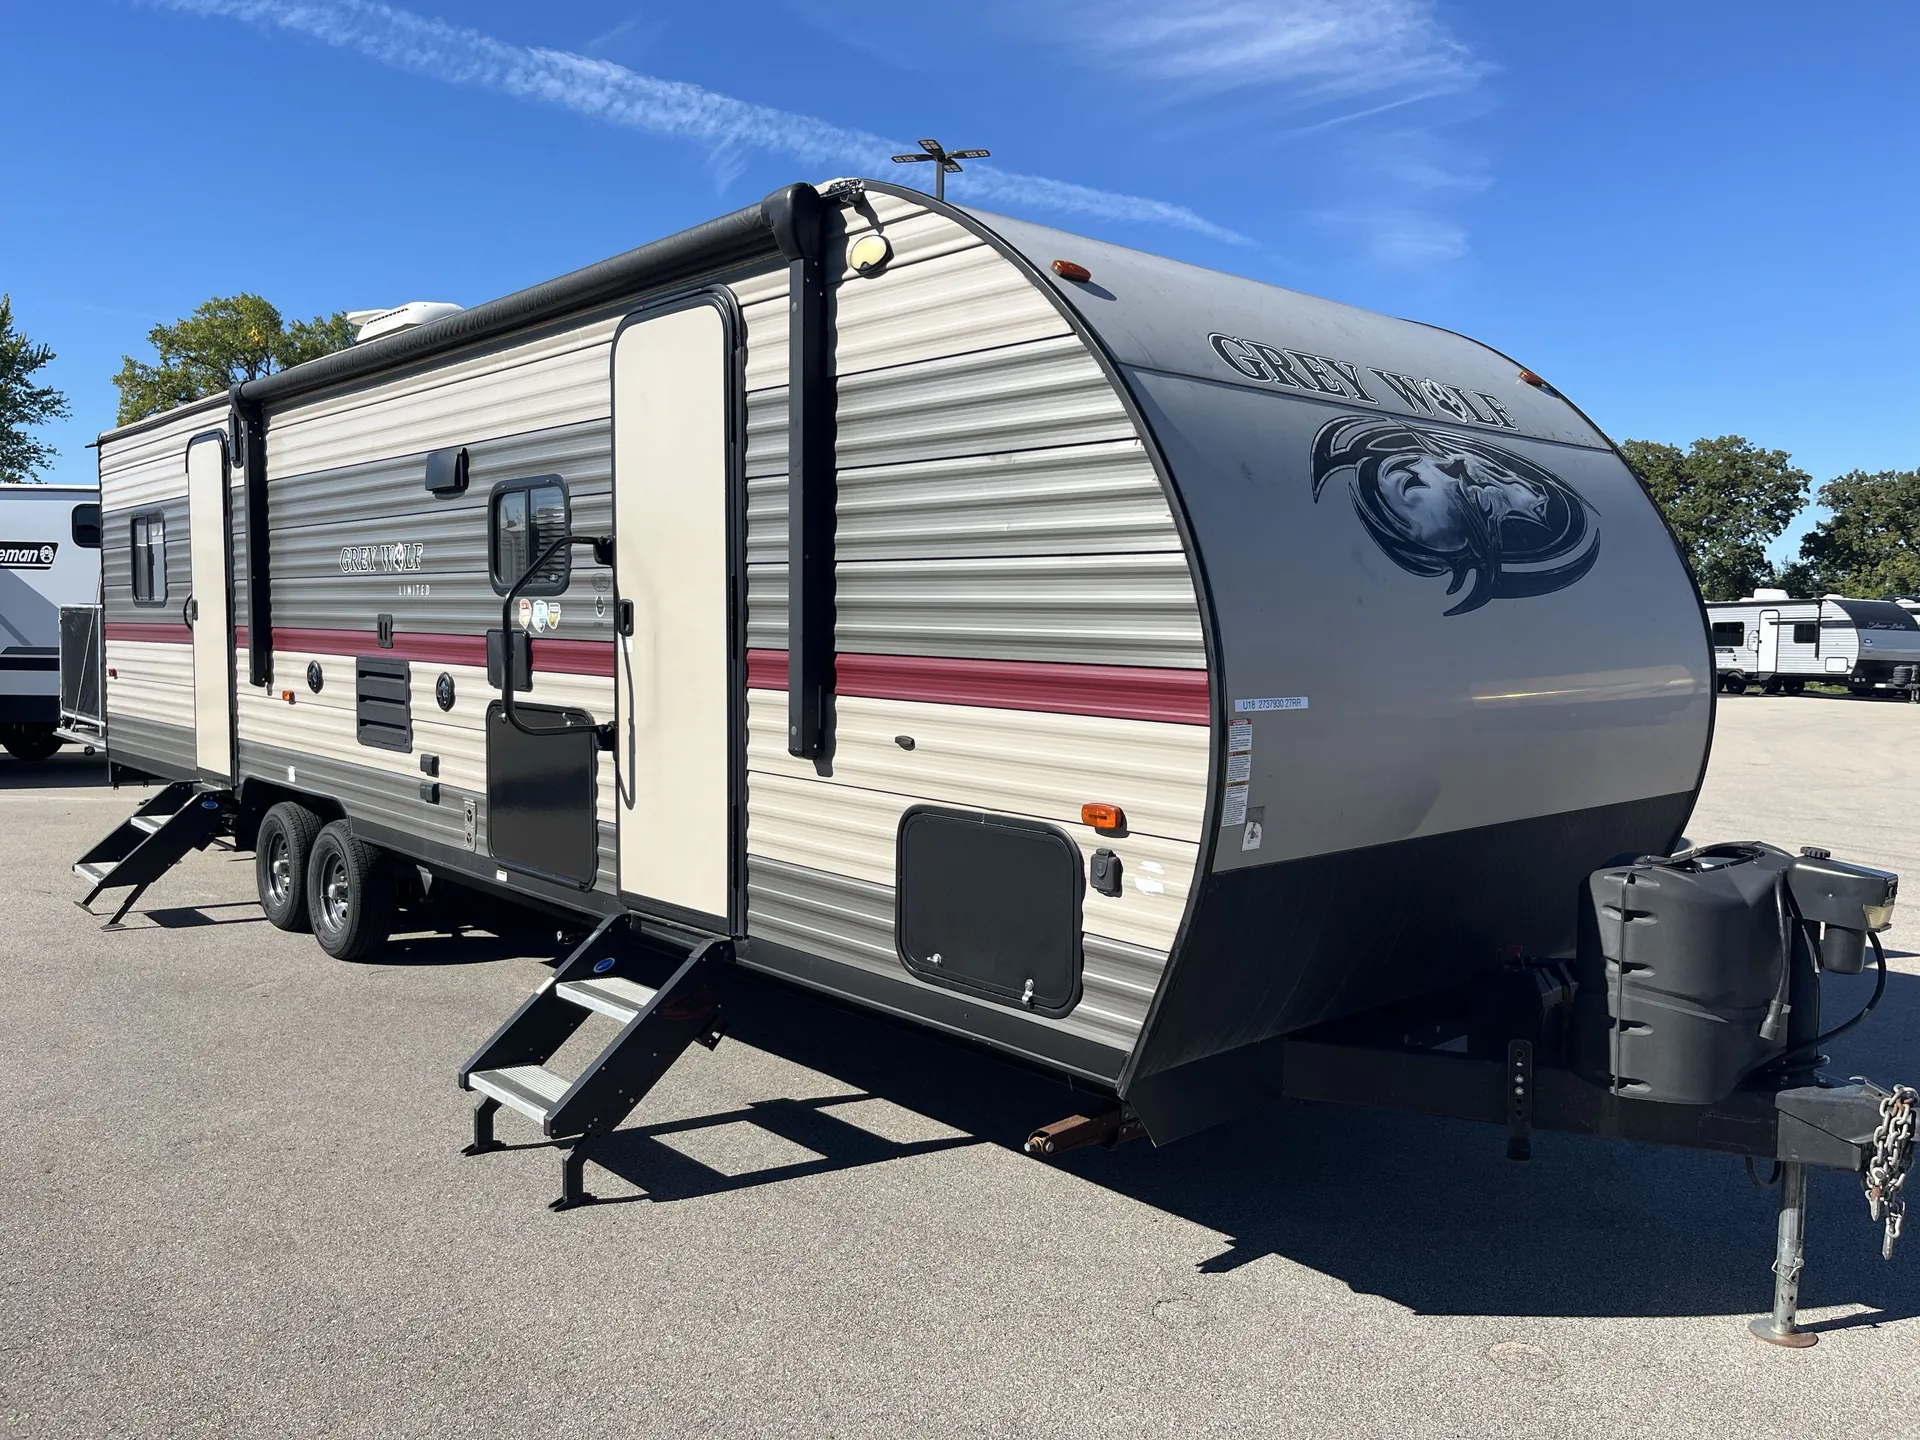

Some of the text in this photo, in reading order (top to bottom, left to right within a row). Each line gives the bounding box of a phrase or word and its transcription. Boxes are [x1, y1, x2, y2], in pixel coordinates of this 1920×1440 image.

[1207, 332, 1379, 405] GREY
[340, 546, 377, 573] GREY
[398, 584, 430, 596] LIMITED
[1242, 700, 1256, 710] U18
